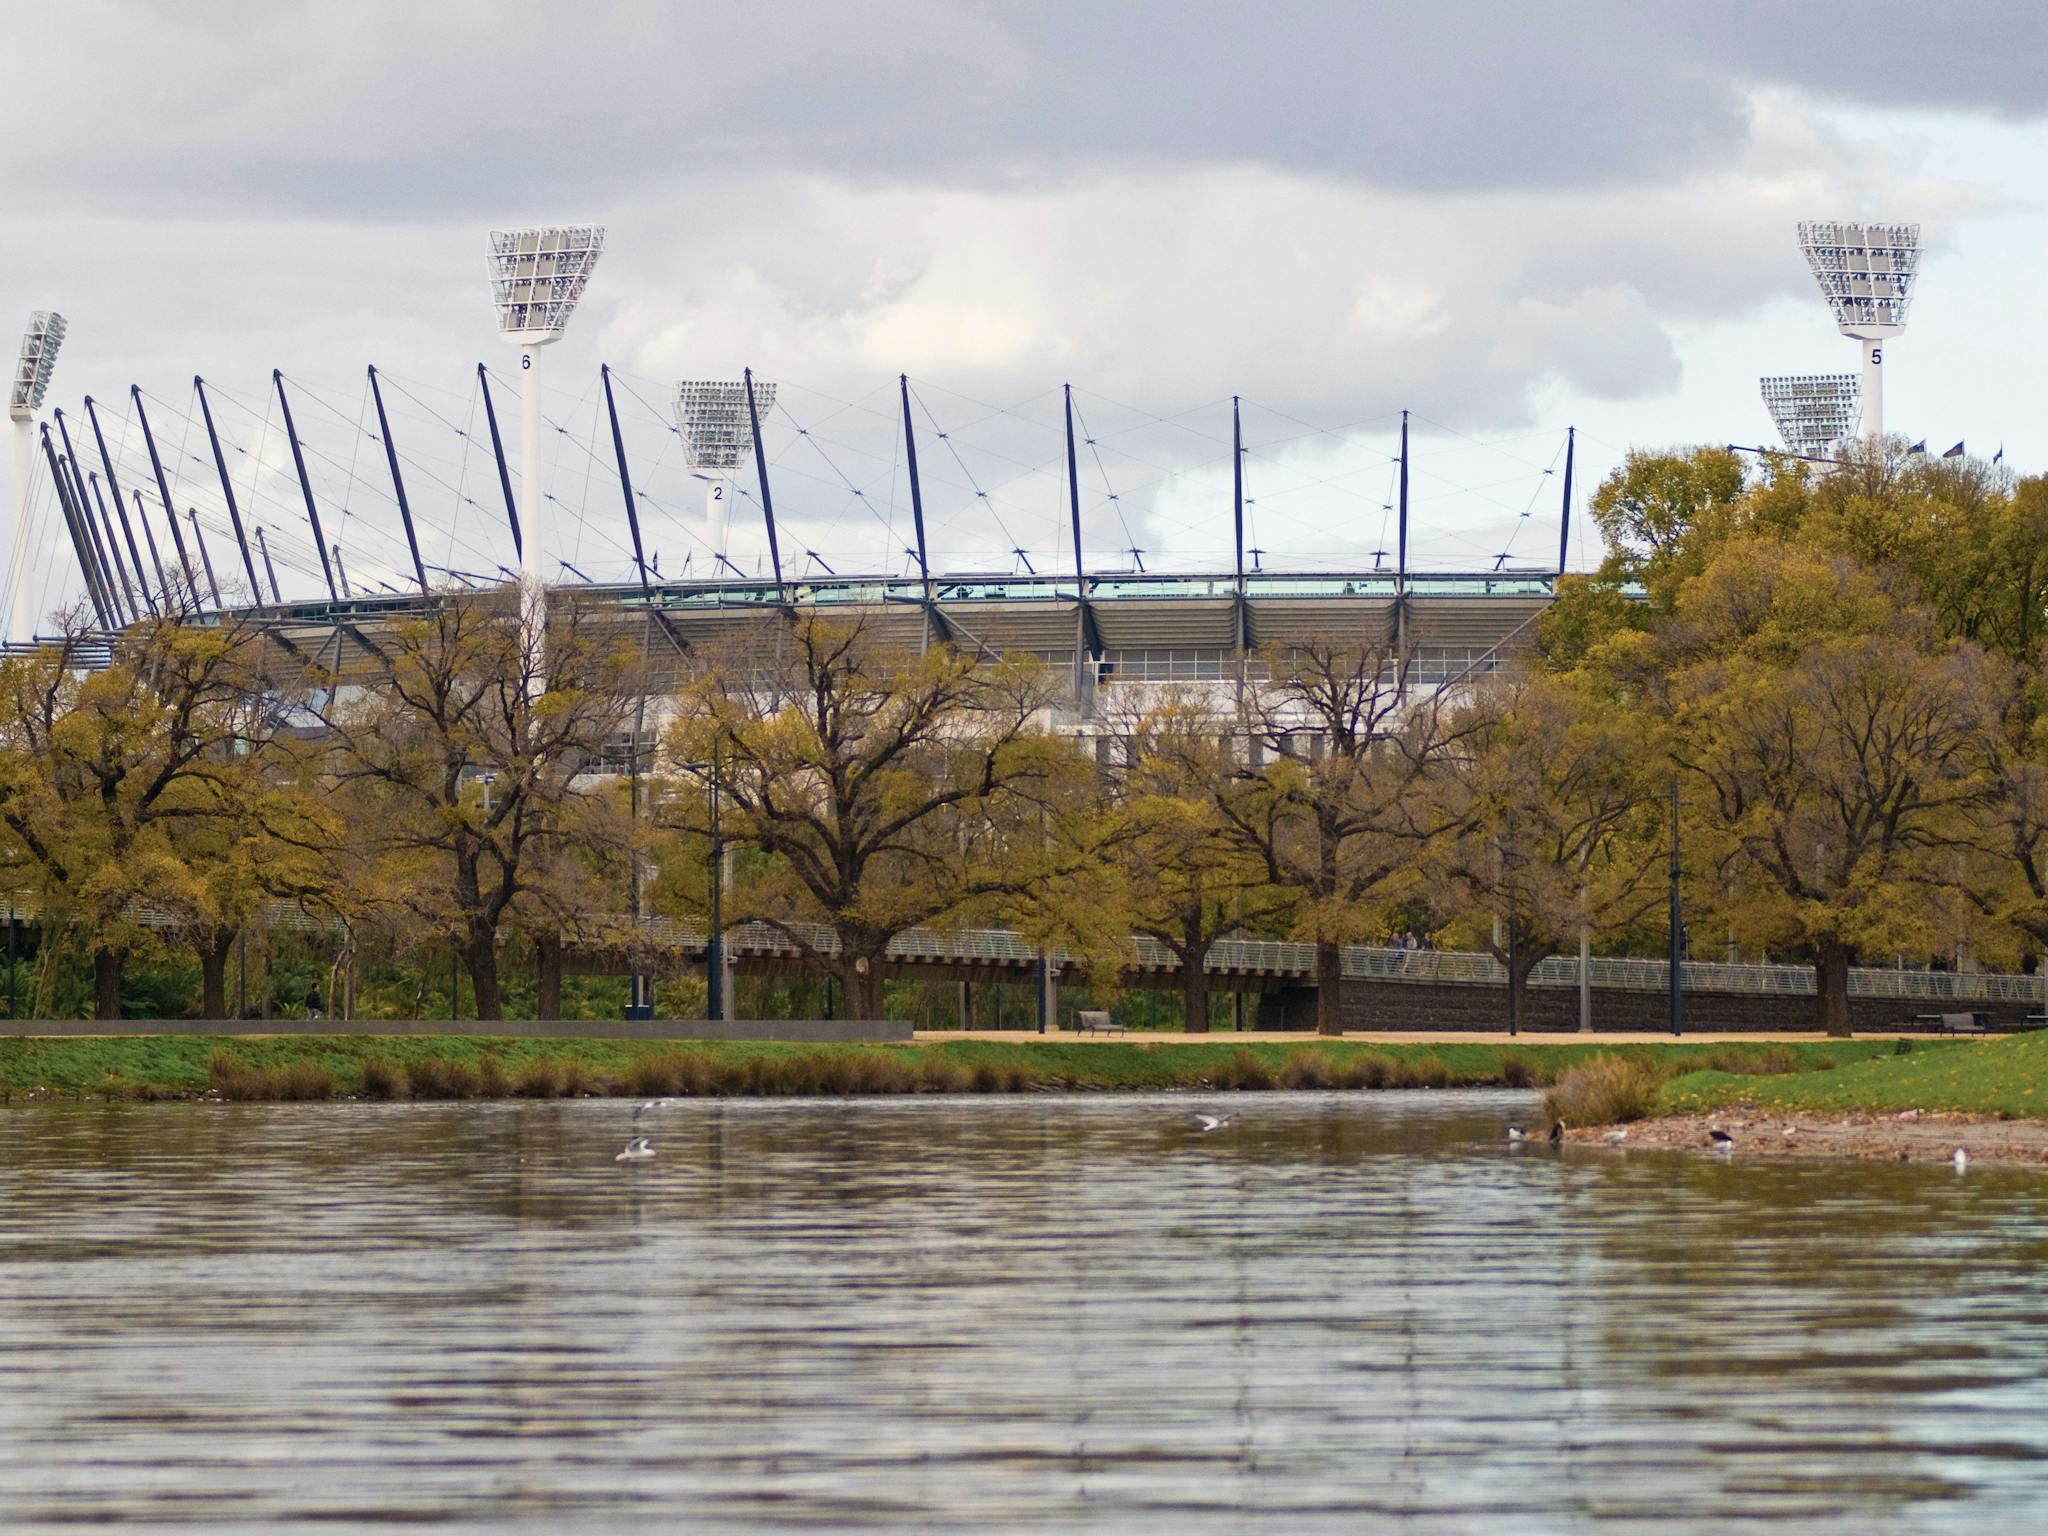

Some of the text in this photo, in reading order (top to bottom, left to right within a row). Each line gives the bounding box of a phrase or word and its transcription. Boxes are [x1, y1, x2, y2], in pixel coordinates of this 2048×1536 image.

[522, 354, 531, 370] 6
[1871, 349, 1882, 365] 5
[714, 487, 723, 500] 2
